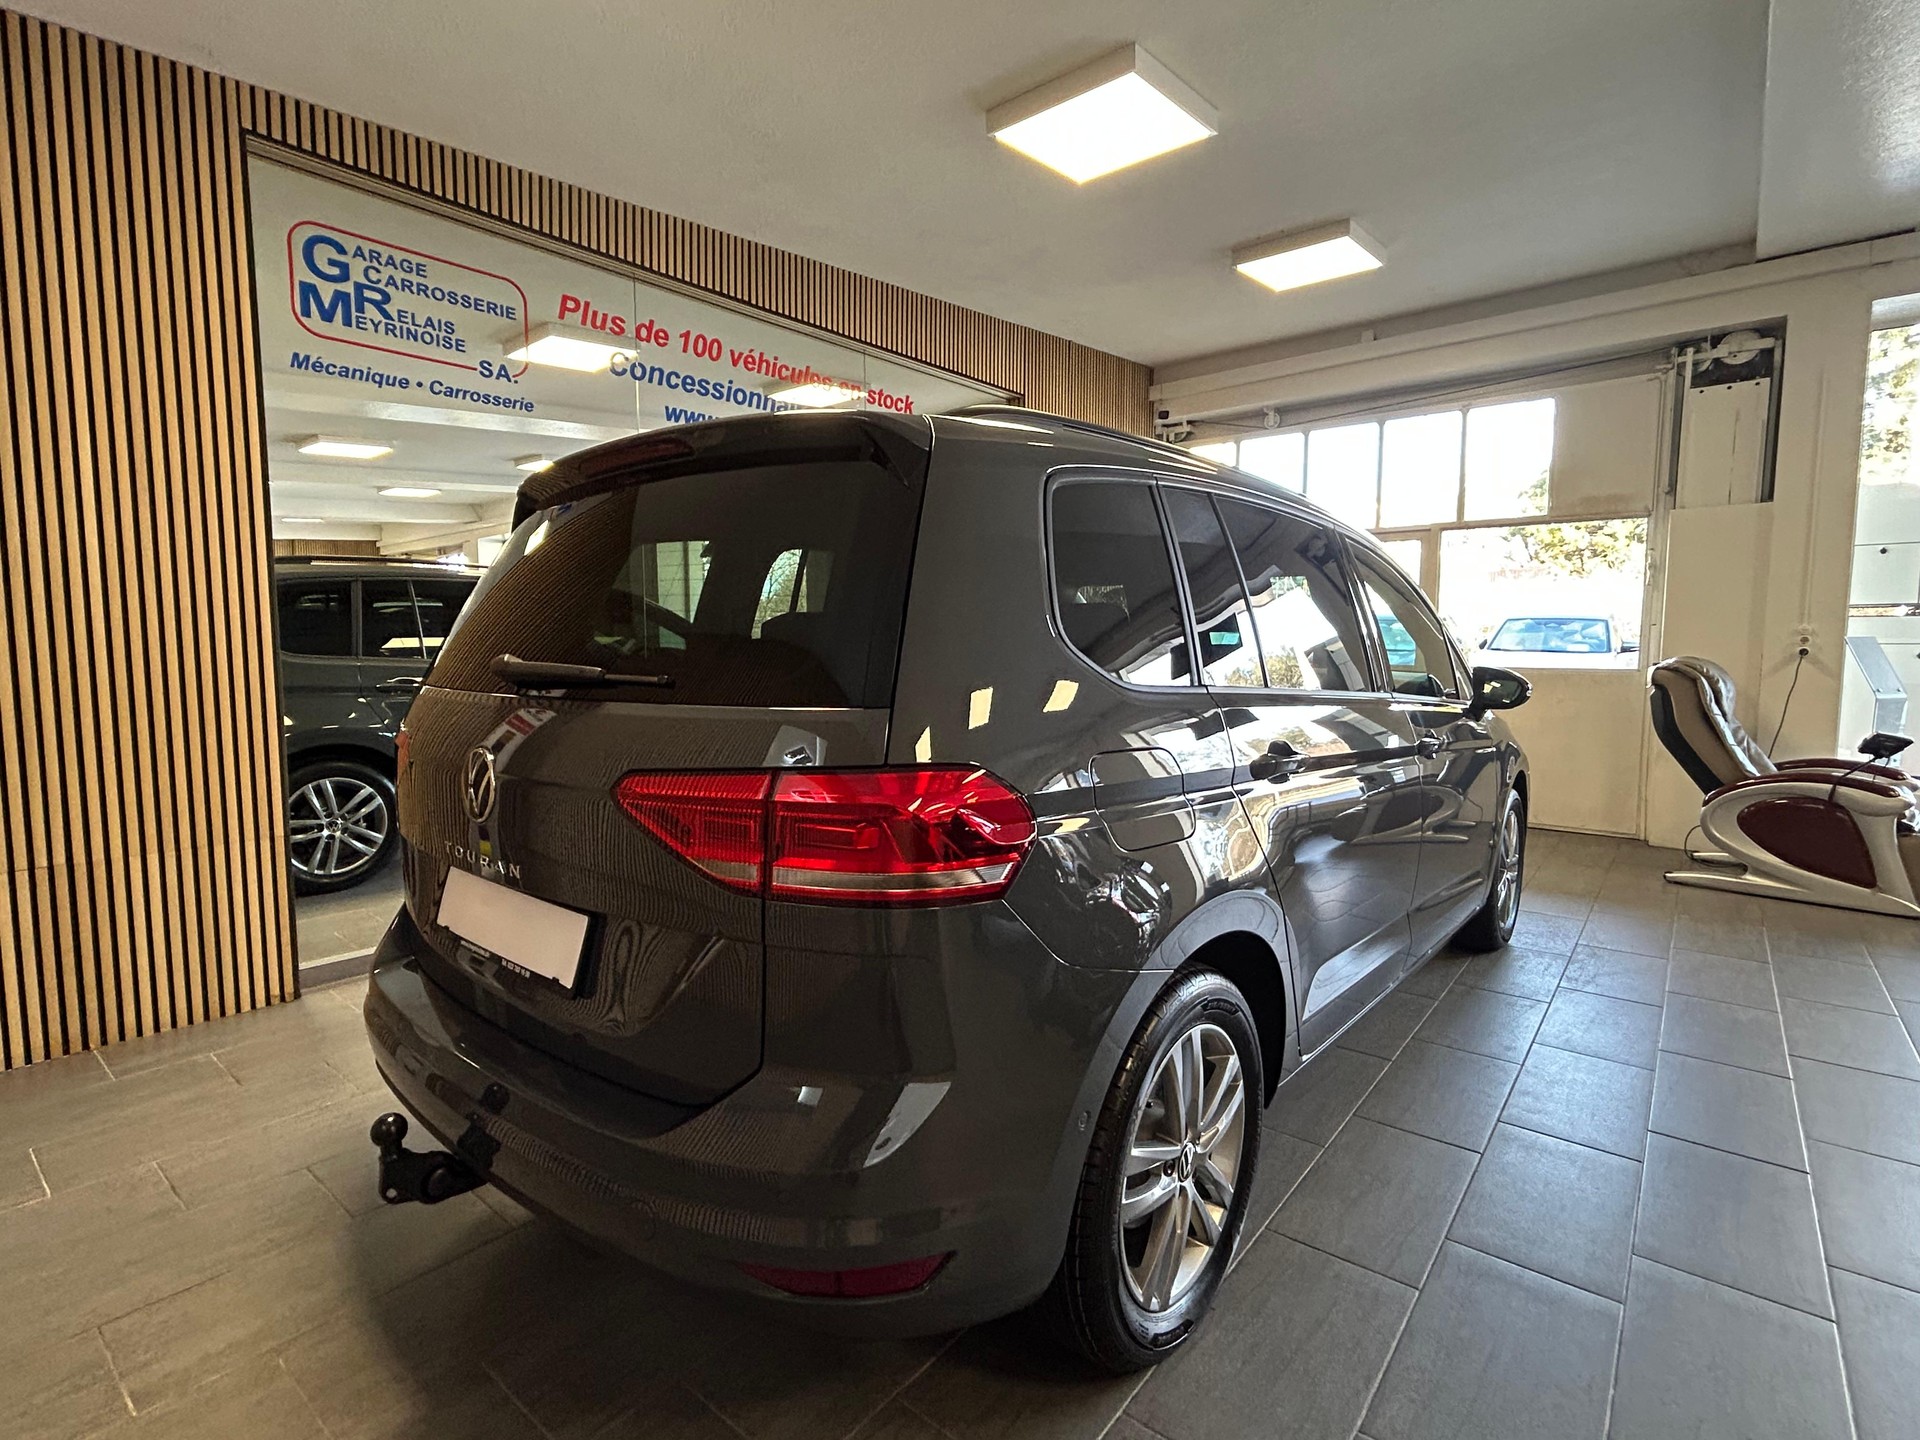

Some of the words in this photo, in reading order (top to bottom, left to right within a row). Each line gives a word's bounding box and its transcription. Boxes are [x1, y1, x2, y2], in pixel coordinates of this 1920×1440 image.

[302, 234, 427, 284] GARAGE
[298, 280, 466, 353] MEYRINOISE
[353, 281, 455, 335] RELAIS
[363, 265, 517, 321] CARROSSERIE
[290, 351, 410, 388] Mécanique
[429, 380, 535, 412] Carrosserie
[558, 294, 626, 336] Plus
[635, 319, 670, 348] de
[679, 329, 723, 362] 100
[729, 349, 833, 391] véhicules
[866, 388, 914, 415] stock
[444, 841, 520, 879] TOURAN
